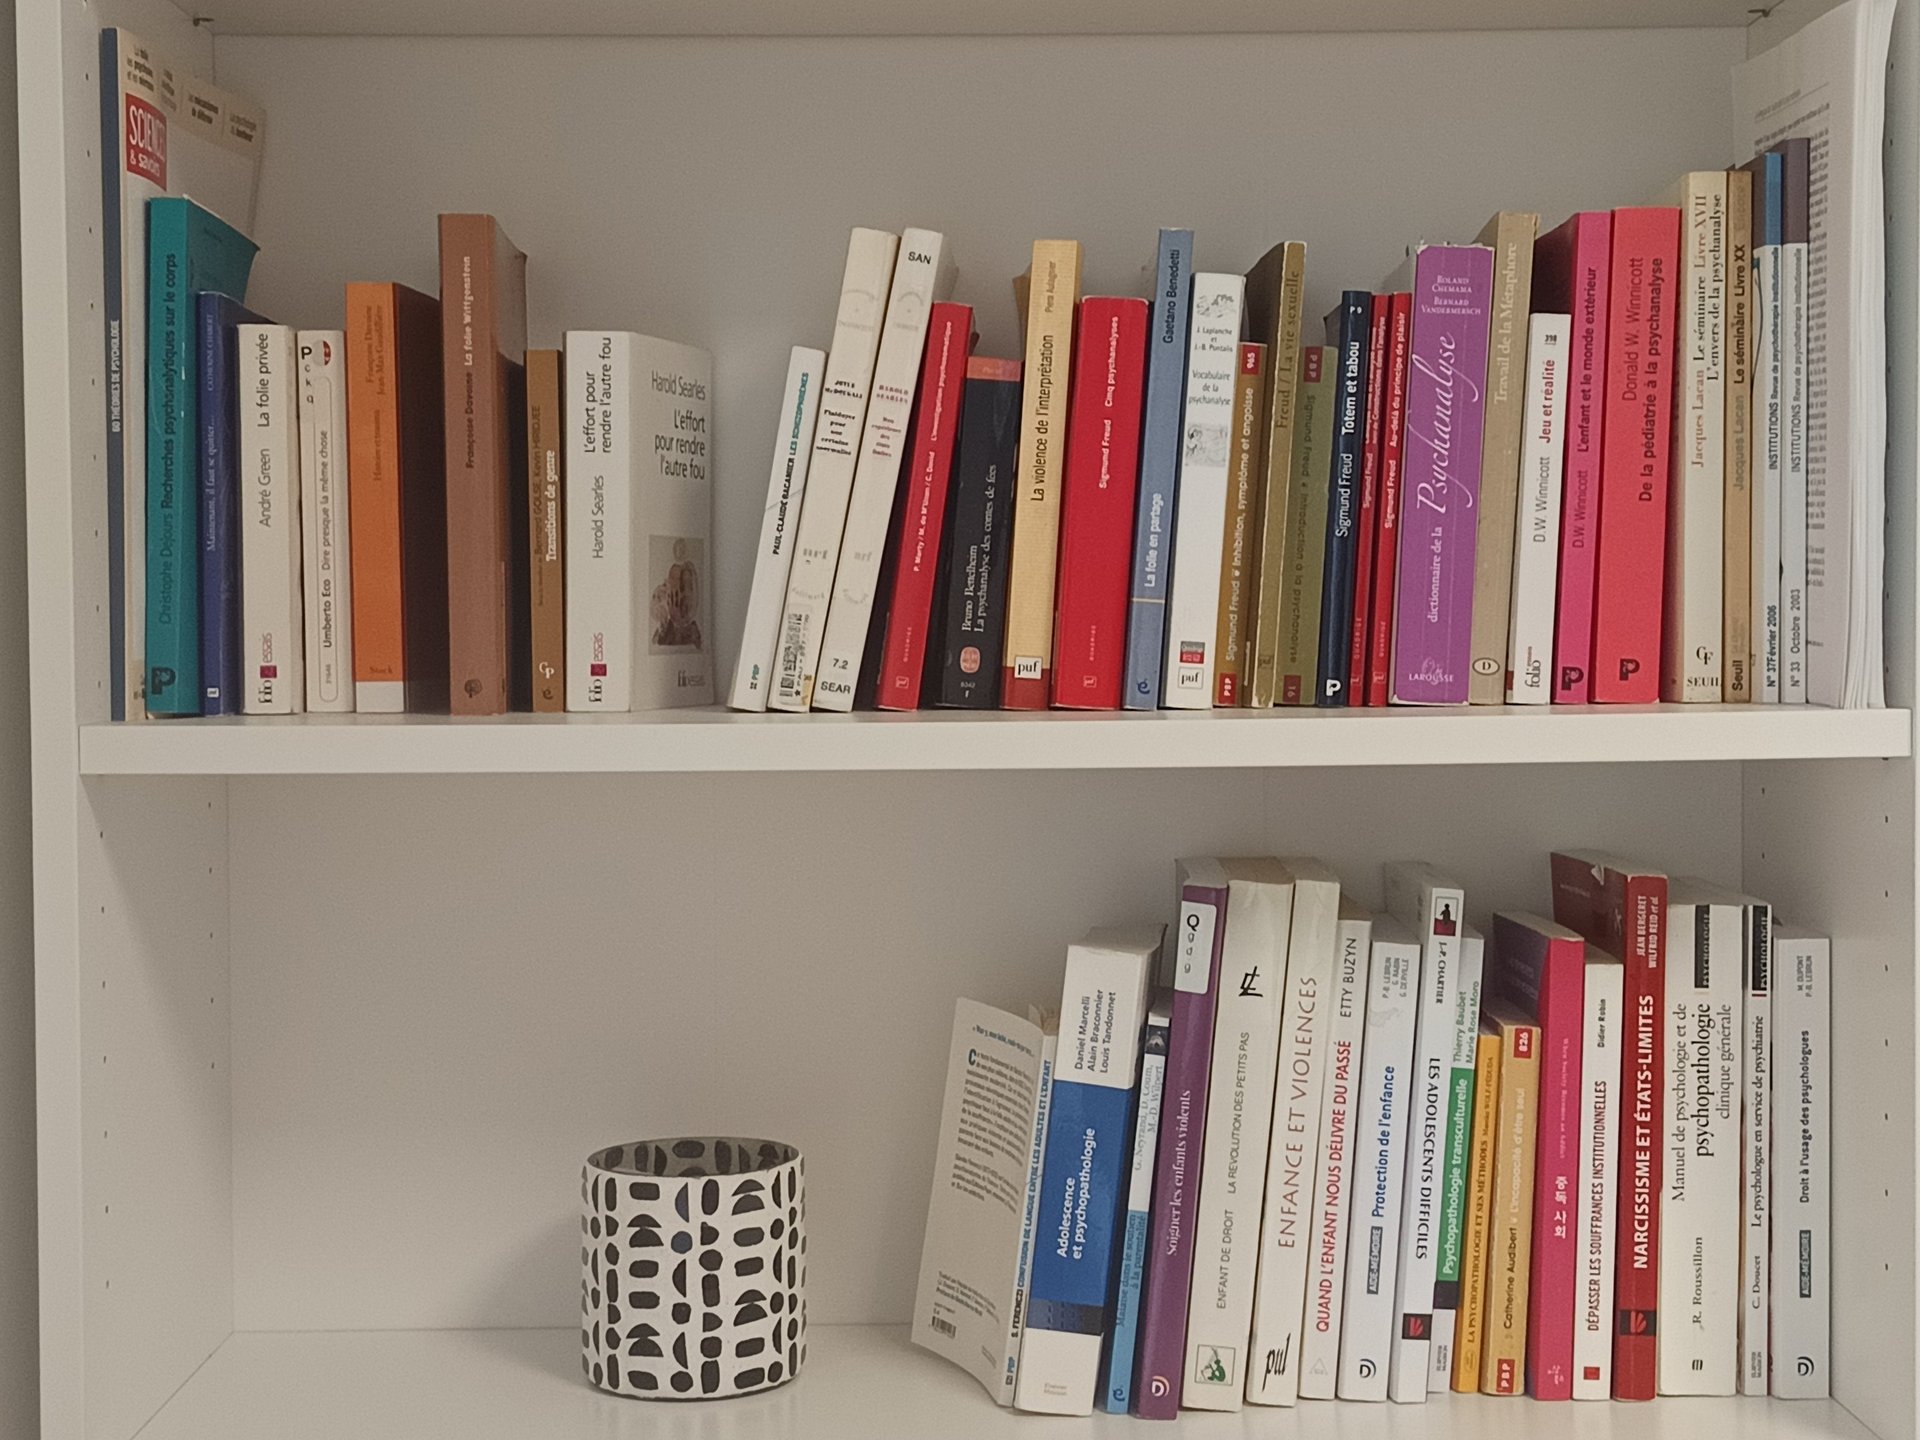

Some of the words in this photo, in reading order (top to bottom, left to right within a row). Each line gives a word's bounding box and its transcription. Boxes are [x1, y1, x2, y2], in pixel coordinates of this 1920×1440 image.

[1708, 193, 1724, 282] psychanalyse
[1733, 243, 1745, 262] XX
[907, 250, 932, 265] SAN
[1165, 248, 1180, 298] Benedetti
[1499, 241, 1518, 318] Métaphore
[1625, 256, 1644, 324] Winnicott
[1707, 286, 1720, 299] la
[1733, 264, 1745, 296] Livre
[1161, 299, 1176, 344] Gaetano
[1646, 257, 1665, 356] psychanalyse
[1693, 275, 1706, 340] séminaire
[1707, 302, 1720, 319] de
[1496, 335, 1512, 354] de
[1497, 320, 1512, 333] la
[1624, 329, 1640, 346] W.
[1733, 301, 1745, 365] séminaire
[255, 332, 272, 374] privée
[597, 336, 612, 360] fou
[1246, 351, 1255, 369] 965
[1345, 341, 1359, 377] tabou
[1581, 327, 1594, 371] monde
[1692, 344, 1705, 360] Le
[1706, 322, 1719, 380] L'envers
[111, 373, 119, 381] DE
[598, 362, 612, 406] l'autre
[1035, 334, 1054, 416] l'interprétation
[1493, 356, 1510, 404] Travail
[1579, 373, 1592, 385] le
[1621, 350, 1639, 401] Donald
[1643, 360, 1658, 374] la
[1645, 379, 1657, 389] à
[1733, 367, 1745, 384] Le
[255, 377, 270, 408] folie
[585, 370, 598, 403] pour
[1345, 379, 1357, 393] et
[1580, 387, 1592, 401] et
[256, 411, 270, 427] La
[1034, 419, 1049, 434] de
[1340, 396, 1356, 435] Totem
[1407, 332, 1479, 514] Psychanalyse
[1541, 403, 1552, 416] et
[1576, 403, 1591, 452] L'enfant
[1641, 393, 1657, 458] pédiatrie
[318, 429, 328, 459] chose
[582, 406, 596, 453] L'effort
[598, 409, 612, 453] rendre
[1538, 419, 1552, 444] Jeu
[257, 447, 271, 486] Green
[318, 460, 329, 492] même
[1032, 437, 1048, 484] violence
[1337, 452, 1353, 485] Freud
[1639, 463, 1654, 477] la
[257, 488, 271, 528] André
[319, 494, 329, 504] la
[590, 474, 604, 516] Searles
[1029, 487, 1045, 501] La
[1637, 481, 1653, 502] De
[321, 506, 331, 547] presque
[1149, 492, 1164, 532] partage
[1334, 487, 1351, 536] Sigmund
[590, 518, 604, 558] Harold
[1148, 533, 1158, 547] en
[1430, 526, 1442, 537] la
[1430, 538, 1442, 553] de
[320, 548, 331, 570] Dire
[1144, 548, 1158, 572] folie
[320, 578, 331, 597] Eco
[1143, 573, 1156, 587] La
[1426, 554, 1441, 622] dictionnaire
[321, 599, 332, 648] Umberto
[832, 657, 849, 670] 7.2
[1408, 673, 1454, 683] LAROUSSE
[1731, 659, 1743, 691] Seuil
[258, 679, 273, 703] folio
[819, 680, 851, 694] SEAR
[1223, 677, 1231, 696] PBP
[1342, 937, 1357, 983] BUZYN
[1077, 995, 1090, 1035] Marcelli
[1089, 988, 1103, 1043] Braconnier
[1101, 991, 1116, 1044] Tandonnet
[1339, 987, 1353, 1018] ETTY
[1671, 1002, 1687, 1020] de
[1290, 976, 1317, 1100] VIOLENCES
[1518, 1031, 1529, 1051] 826
[1675, 1024, 1686, 1037] et
[1715, 1003, 1734, 1062] générale
[1751, 1014, 1766, 1073] psychiatrie
[1073, 1036, 1086, 1070] Daniel
[1086, 1044, 1098, 1072] Alain
[1099, 1046, 1110, 1073] Louis
[1333, 1039, 1351, 1081] PASSÉ
[1427, 1057, 1440, 1080] LES
[1633, 994, 1653, 1121] ÉTATS-LIMITES
[1798, 1029, 1813, 1104] psychologues
[1332, 1083, 1348, 1104] DU
[1377, 1065, 1395, 1127] l'enfance
[1671, 1040, 1690, 1121] psychologie
[1689, 1002, 1716, 1157] psychopathologie
[1714, 1064, 1734, 1119] clinique
[1751, 1074, 1763, 1089] de
[1286, 1106, 1305, 1133] ET
[1451, 1077, 1468, 1165] transculturelle
[1751, 1090, 1763, 1127] service
[1799, 1105, 1810, 1126] des
[1325, 1108, 1346, 1161] DÉLIVRE
[1376, 1129, 1390, 1146] de
[1420, 1082, 1438, 1183] ADOLESCENTS
[1591, 1080, 1607, 1179] INSTITUTIONNELLES
[1635, 1124, 1650, 1146] ET
[1670, 1124, 1686, 1142] de
[1754, 1129, 1763, 1142] en
[1799, 1127, 1813, 1166] l'usage
[1074, 1127, 1097, 1243] psychopathologie
[1324, 1164, 1342, 1207] NOUS
[1370, 1148, 1388, 1218] Protection
[1670, 1146, 1685, 1201] Manuel
[1750, 1144, 1765, 1211] psychologue
[1798, 1176, 1810, 1203] Droit
[1277, 1142, 1303, 1248] ENFANCE
[1633, 1150, 1650, 1268] NARCISSISME
[1056, 1176, 1075, 1257] Adolescence
[1221, 1208, 1234, 1244] DROIT
[1414, 1186, 1432, 1259] DIFFICILES
[1442, 1166, 1463, 1274] Psychopathologie
[1589, 1181, 1604, 1255] SOUFFRANCES
[1750, 1212, 1762, 1227] Le
[1072, 1244, 1083, 1259] et
[1219, 1246, 1231, 1262] DE
[1319, 1209, 1338, 1275] L'ENFANT
[1506, 1226, 1517, 1273] Audibert
[1588, 1257, 1602, 1276] LES
[1215, 1264, 1229, 1309] ENFANT
[1315, 1277, 1333, 1332] QUAND
[1502, 1275, 1515, 1329] Catherine
[1585, 1278, 1600, 1331] DÉPASSER
[1500, 1362, 1510, 1387] PBP
